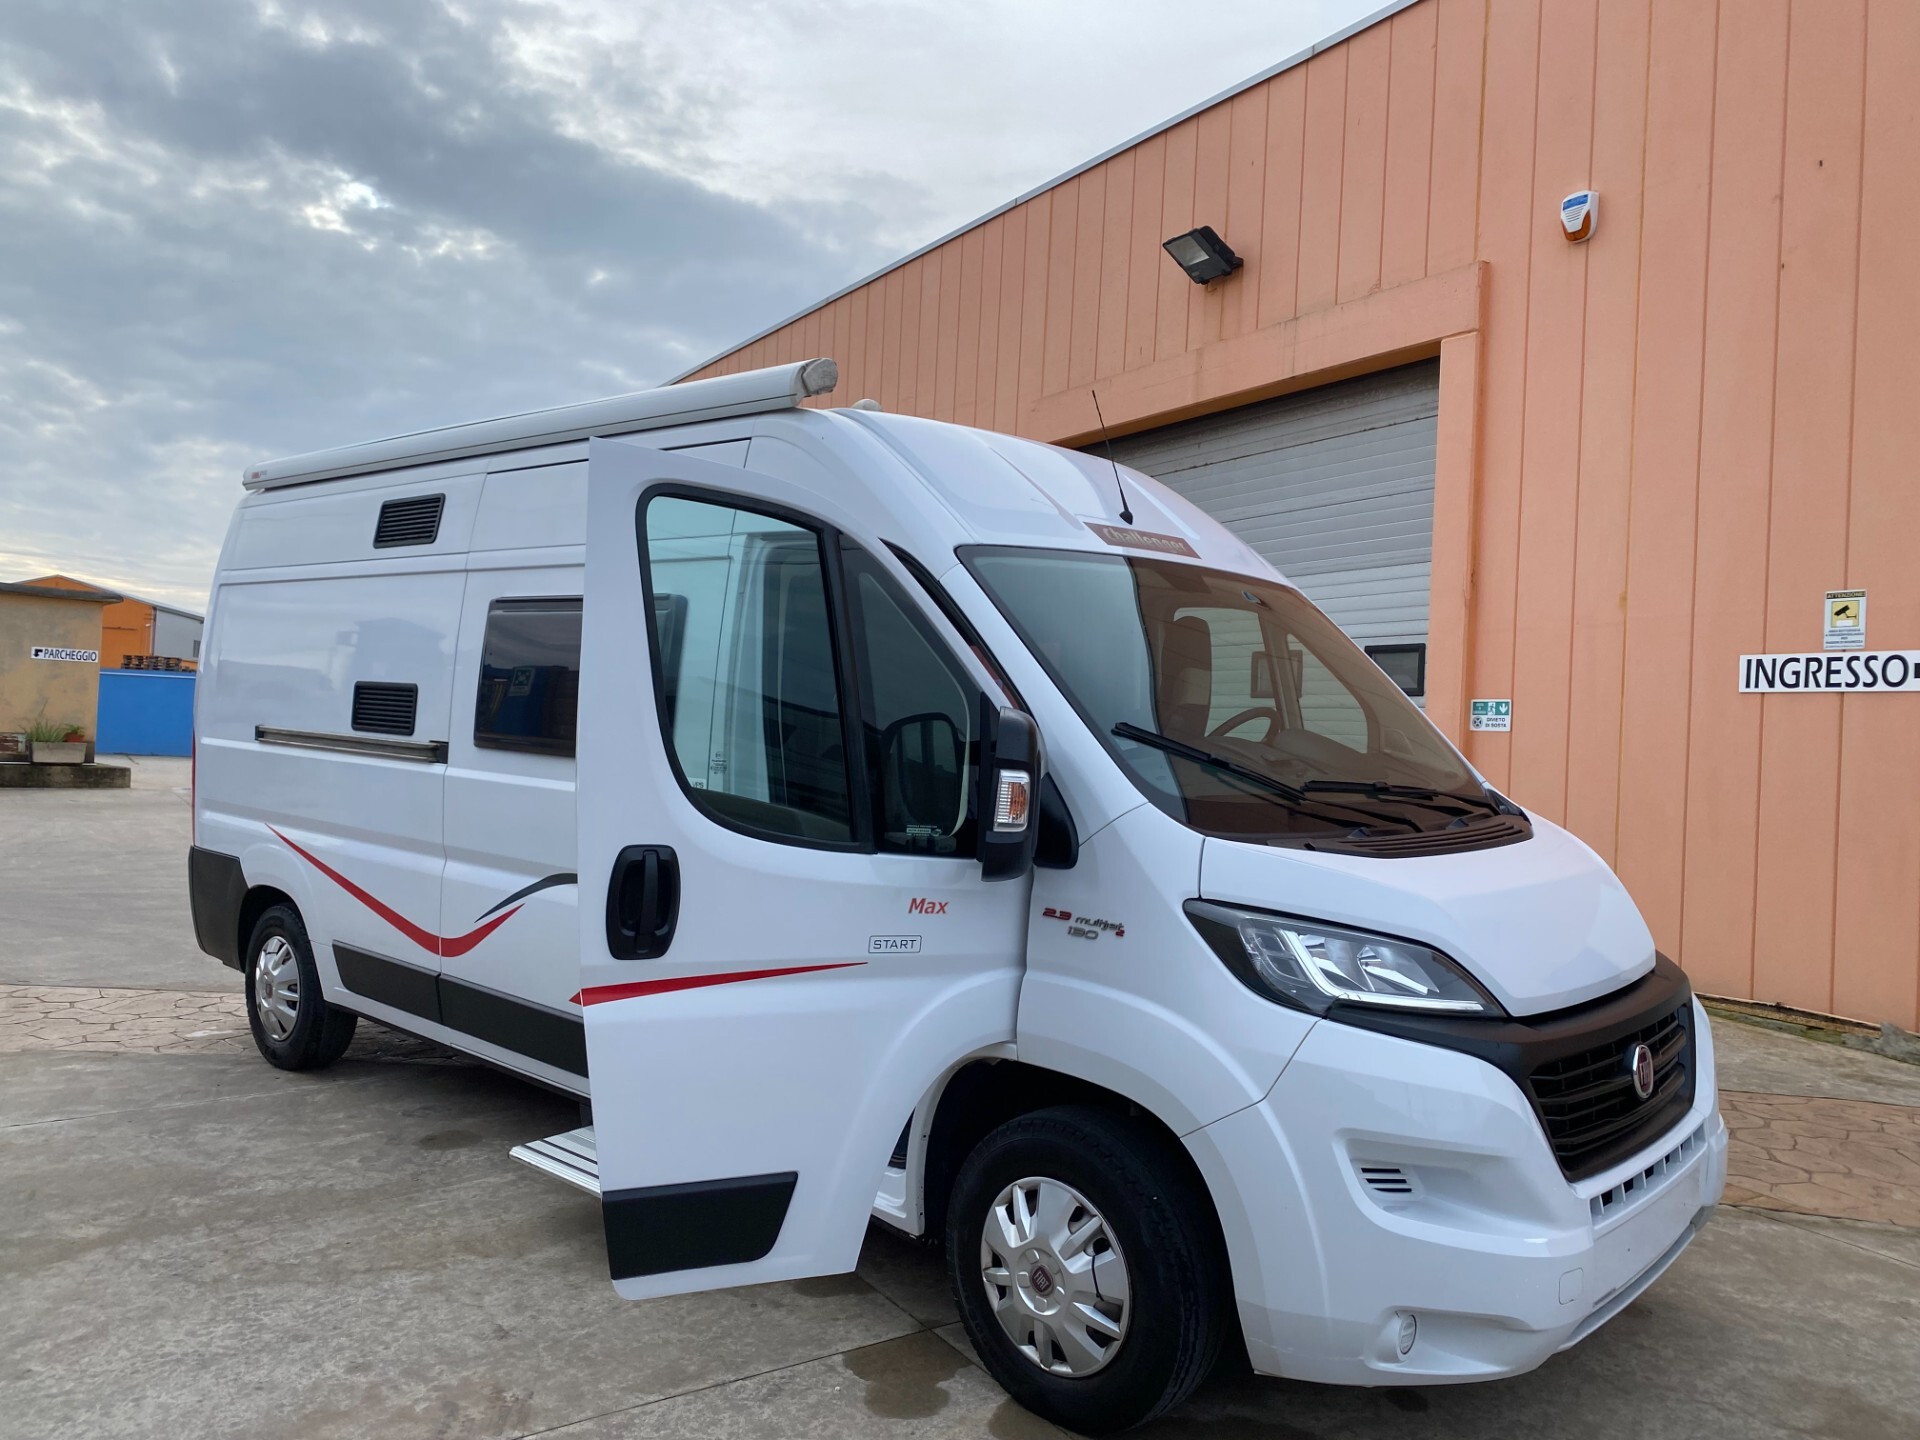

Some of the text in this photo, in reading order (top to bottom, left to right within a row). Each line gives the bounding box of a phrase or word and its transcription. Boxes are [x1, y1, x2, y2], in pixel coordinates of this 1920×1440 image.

[43, 648, 97, 661] PARCHEGGIO
[1745, 654, 1909, 688] INGRESSO
[908, 897, 949, 914] Max
[1042, 907, 1072, 920] 2.3
[1067, 925, 1099, 940] 130
[873, 939, 917, 949] START
[1033, 1271, 1050, 1290] FIAT
